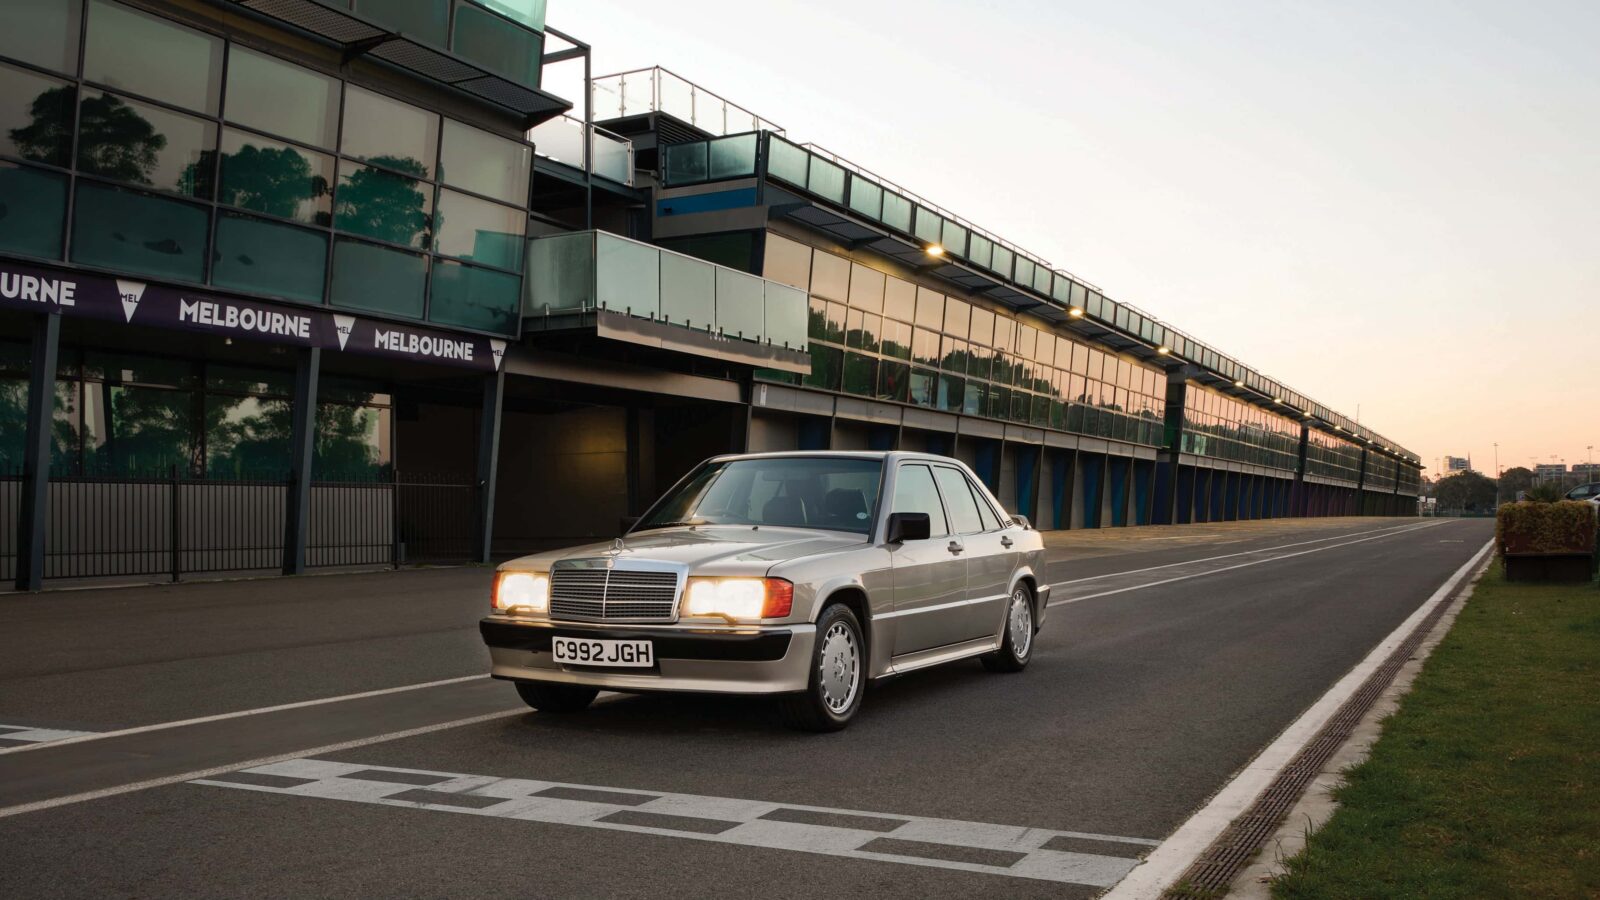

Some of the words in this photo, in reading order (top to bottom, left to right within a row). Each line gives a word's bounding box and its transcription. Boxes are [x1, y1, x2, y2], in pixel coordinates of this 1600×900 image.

[1, 272, 77, 307] URNE
[120, 293, 140, 304] MEL
[179, 298, 311, 339] MELBOURNE
[336, 326, 351, 335] MEL
[374, 328, 474, 361] MELBOURNE
